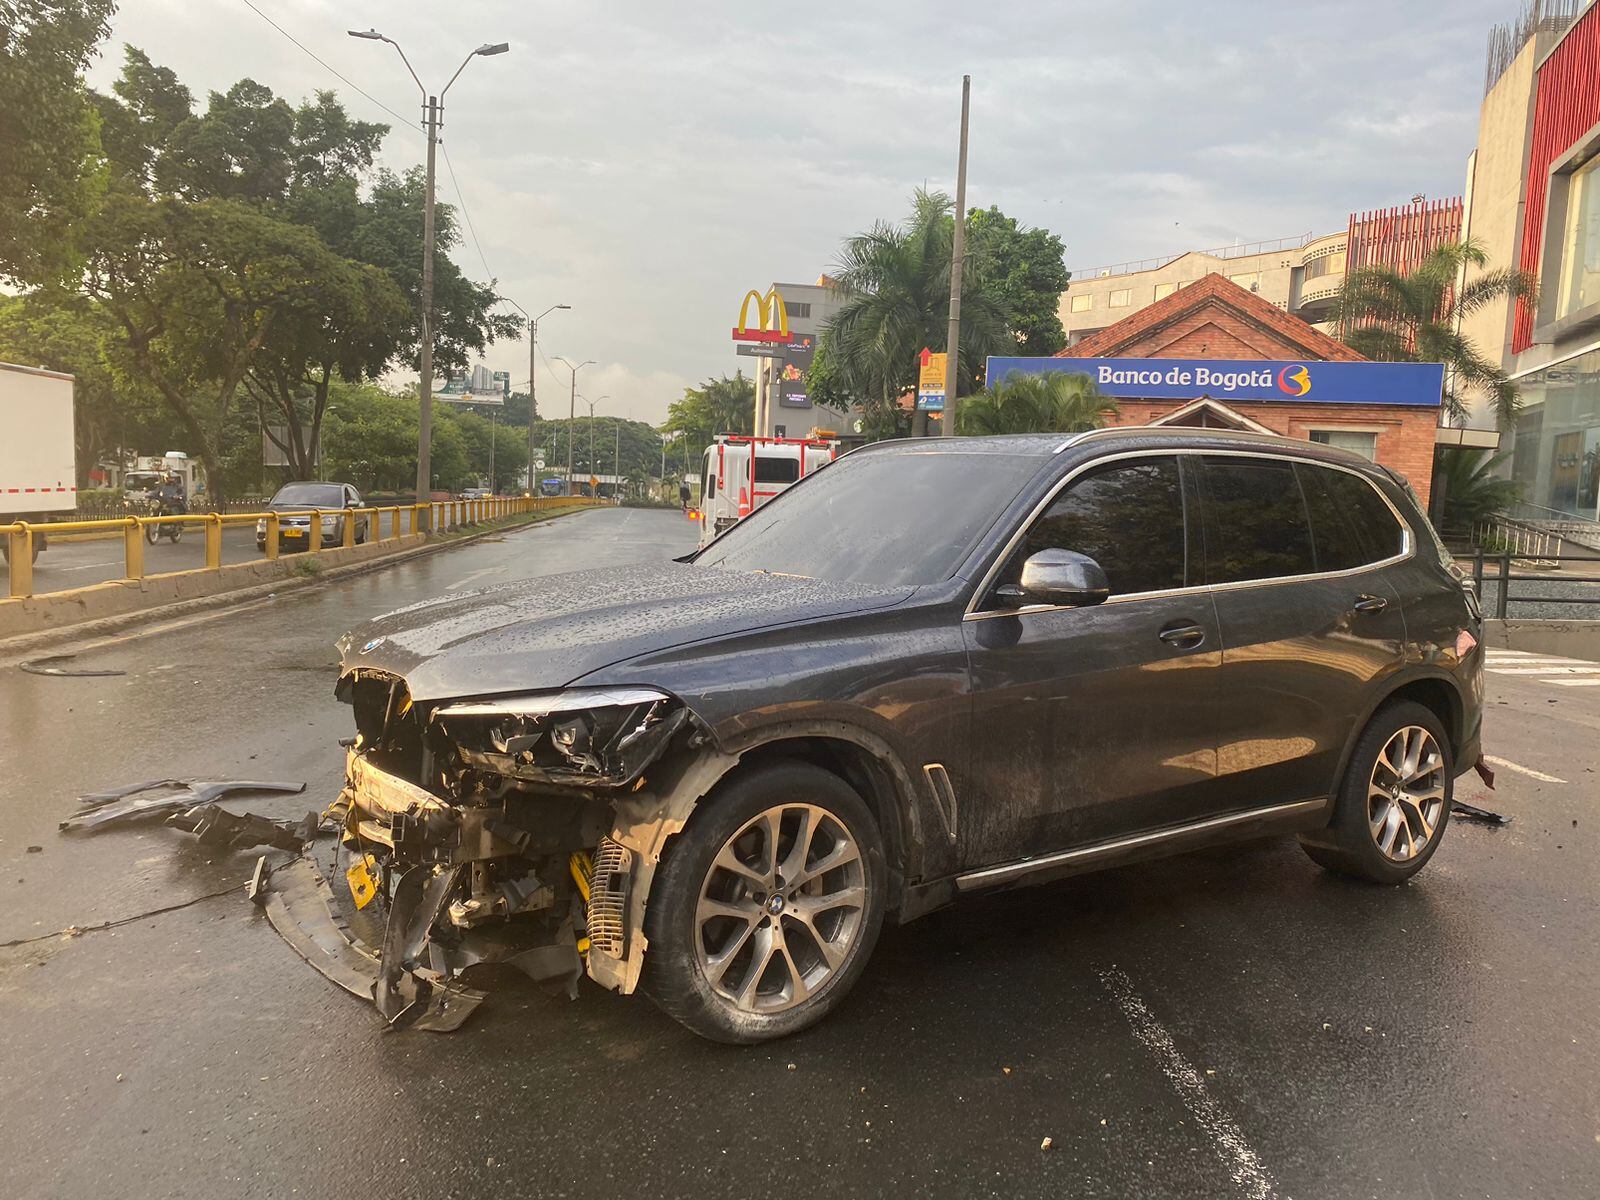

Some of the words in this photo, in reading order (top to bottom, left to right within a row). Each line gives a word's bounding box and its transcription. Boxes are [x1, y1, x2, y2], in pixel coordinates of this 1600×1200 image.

[1097, 366, 1163, 385] Banco
[1165, 367, 1192, 386] de
[1195, 368, 1273, 391] Bogotá
